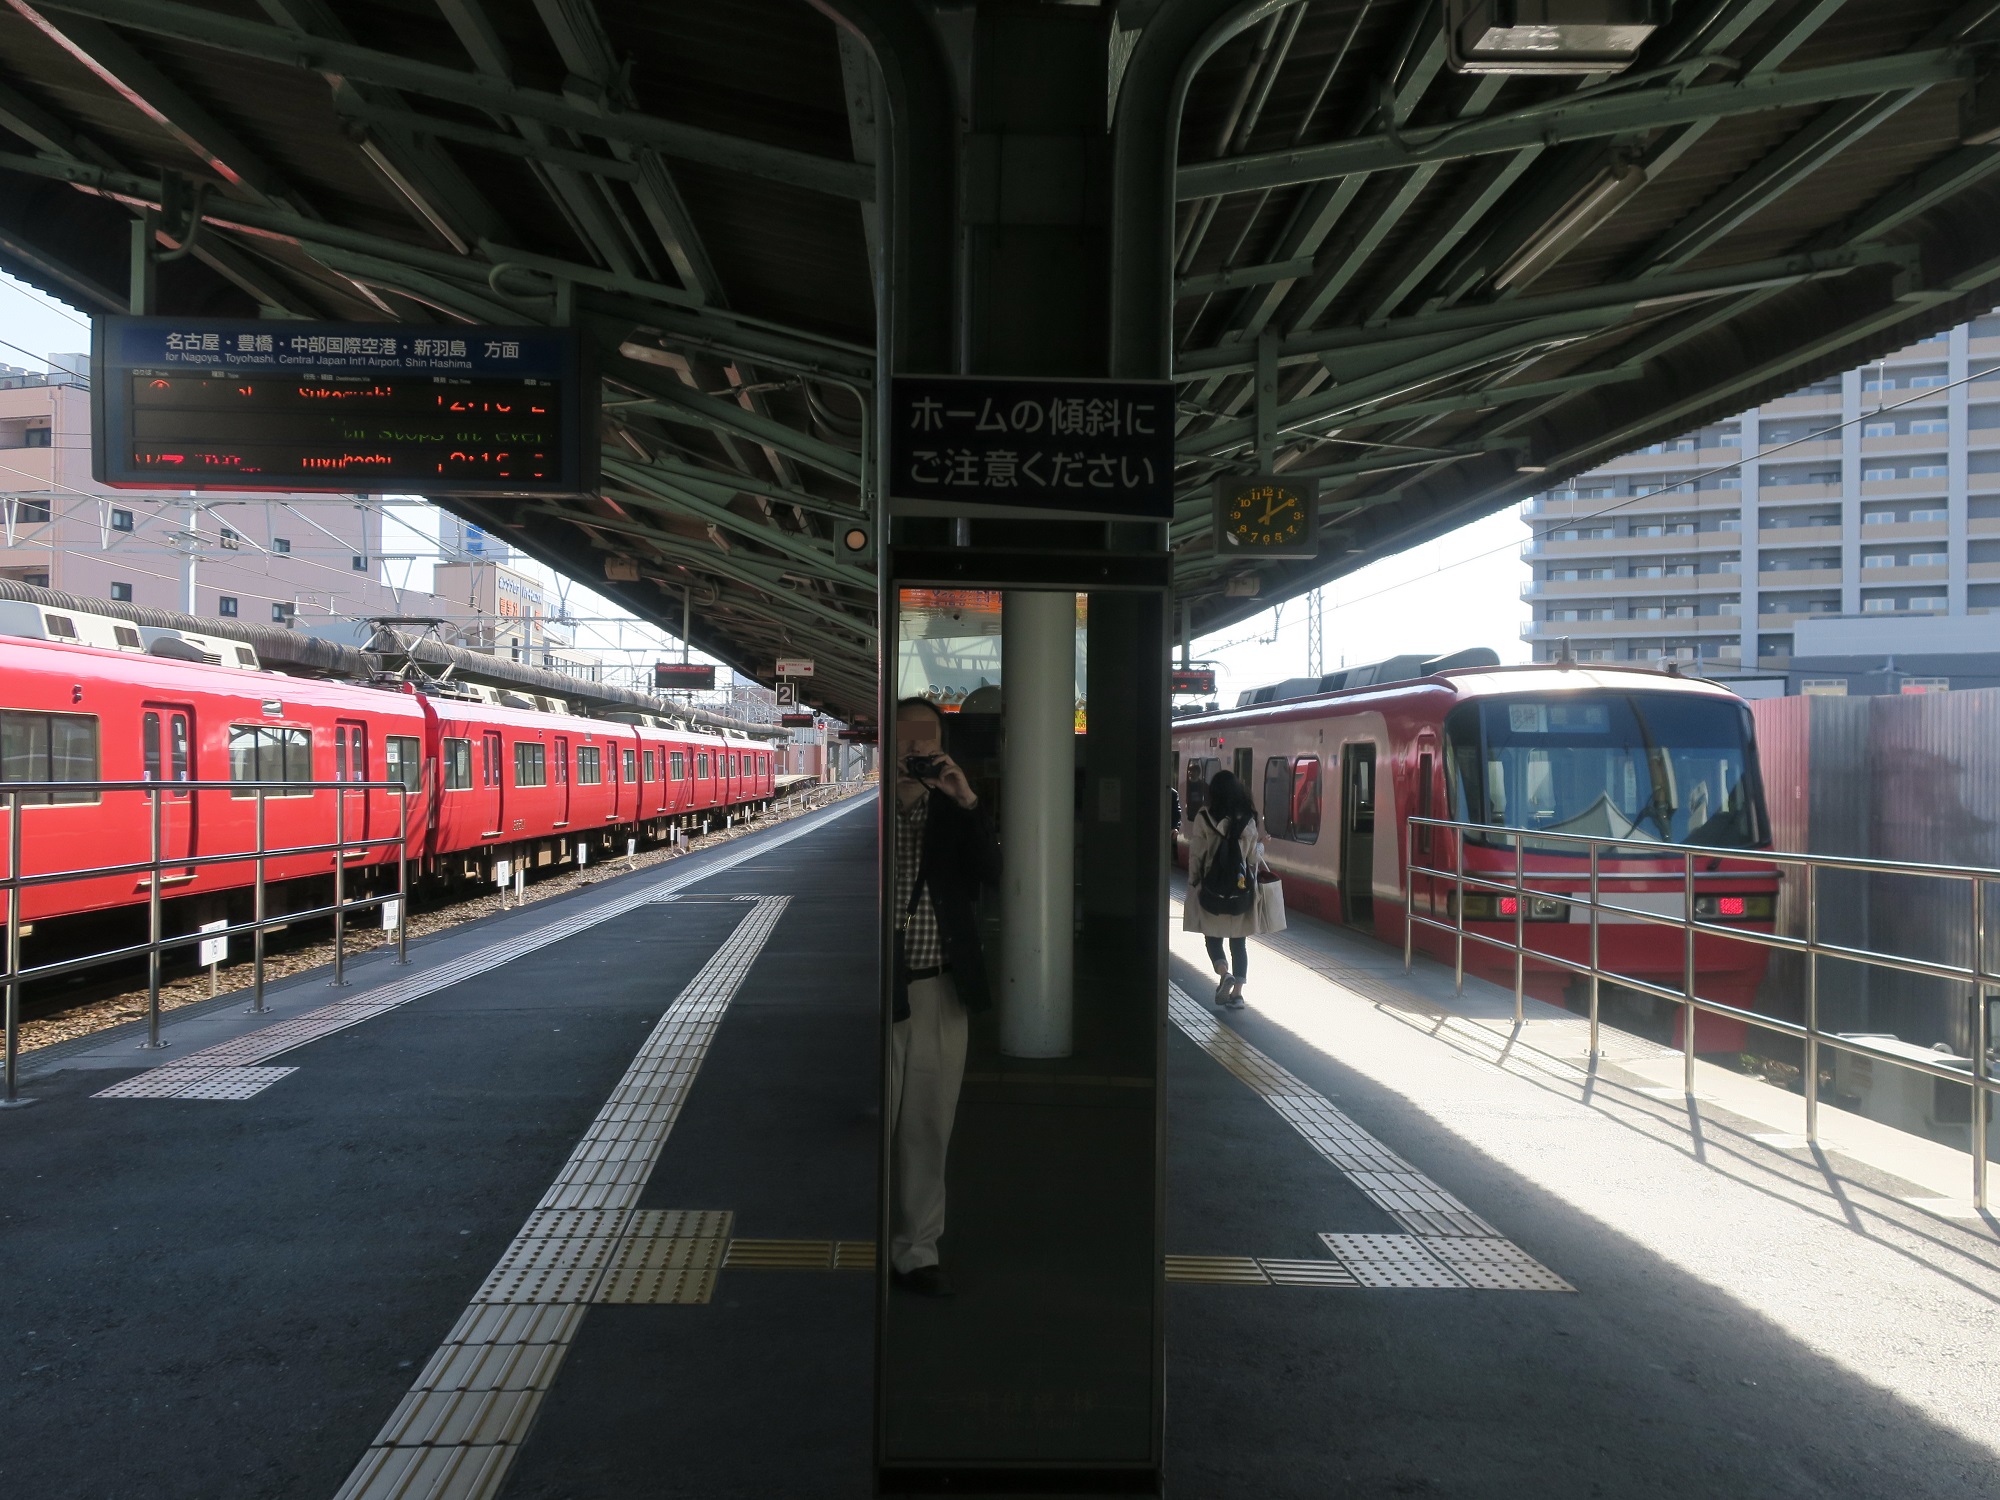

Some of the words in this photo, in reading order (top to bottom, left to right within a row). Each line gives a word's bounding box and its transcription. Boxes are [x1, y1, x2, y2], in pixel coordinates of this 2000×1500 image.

[166, 332, 467, 357] 名古屋・豊橋・中部国際空港・新羽島
[484, 341, 520, 359] 方面
[165, 352, 180, 362] for
[181, 353, 222, 363] Nagoya,
[224, 353, 276, 365] Toyohashi,
[279, 354, 314, 364] Central
[316, 355, 346, 366] Japan
[349, 356, 366, 366] Int'l
[367, 357, 402, 368] Airport,
[405, 358, 427, 367] Shin
[429, 358, 473, 369] Hashima
[911, 396, 1156, 437] ホームの傾斜に
[911, 449, 1155, 488] ご注意ください
[1251, 492, 1260, 500] 11
[1262, 488, 1273, 497] 12
[1277, 491, 1283, 499] 1
[1240, 499, 1251, 507] 10
[1233, 511, 1241, 519] 9
[1293, 512, 1300, 520] 3
[1240, 525, 1247, 533] 8
[1286, 525, 1294, 533] 4
[1251, 532, 1259, 540] 7
[1263, 534, 1270, 542] 6
[1274, 532, 1282, 540] 5
[779, 686, 791, 703] 2
